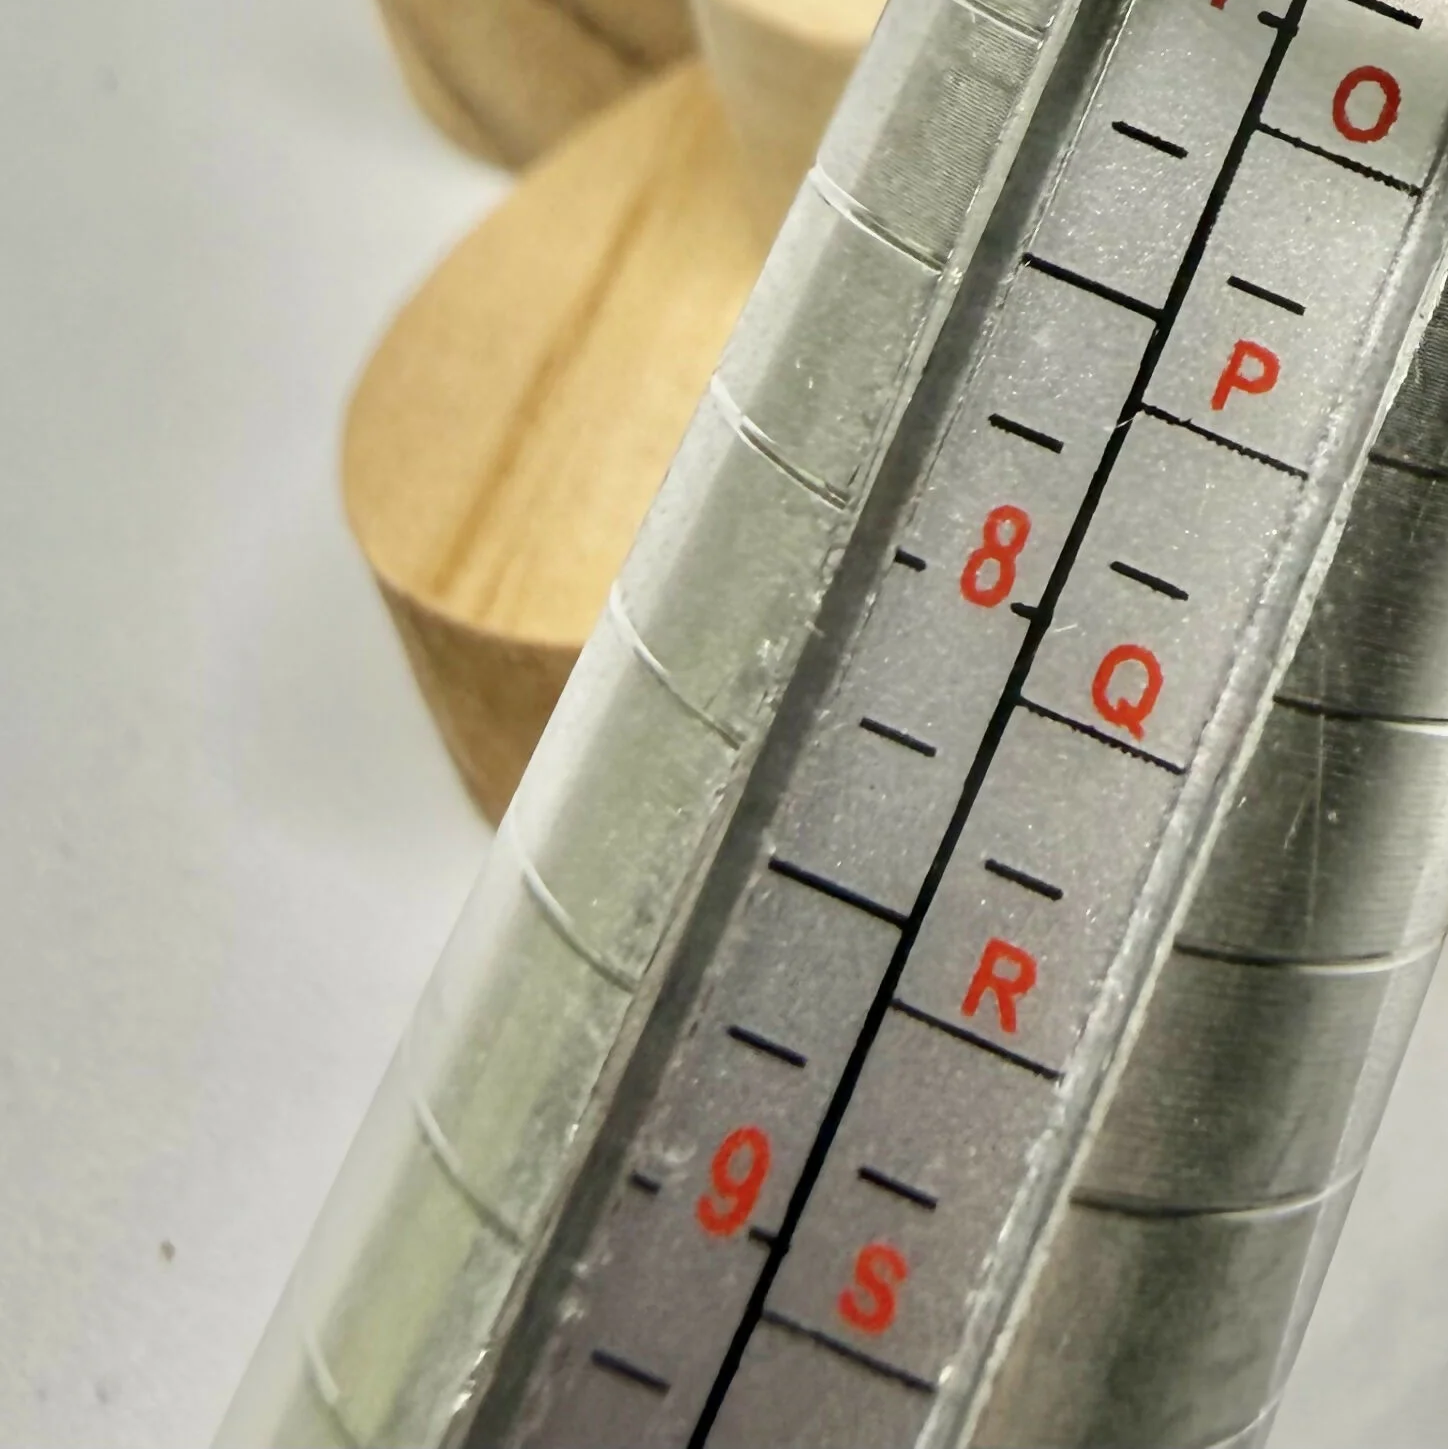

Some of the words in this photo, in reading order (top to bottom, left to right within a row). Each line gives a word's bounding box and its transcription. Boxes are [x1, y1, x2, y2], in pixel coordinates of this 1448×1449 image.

[1333, 65, 1401, 143] O
[1211, 340, 1280, 411] P
[960, 505, 1031, 608] 8
[1091, 644, 1163, 740] Q
[961, 938, 1037, 1033] R
[697, 1125, 771, 1236] 9
[837, 1243, 909, 1335] S
